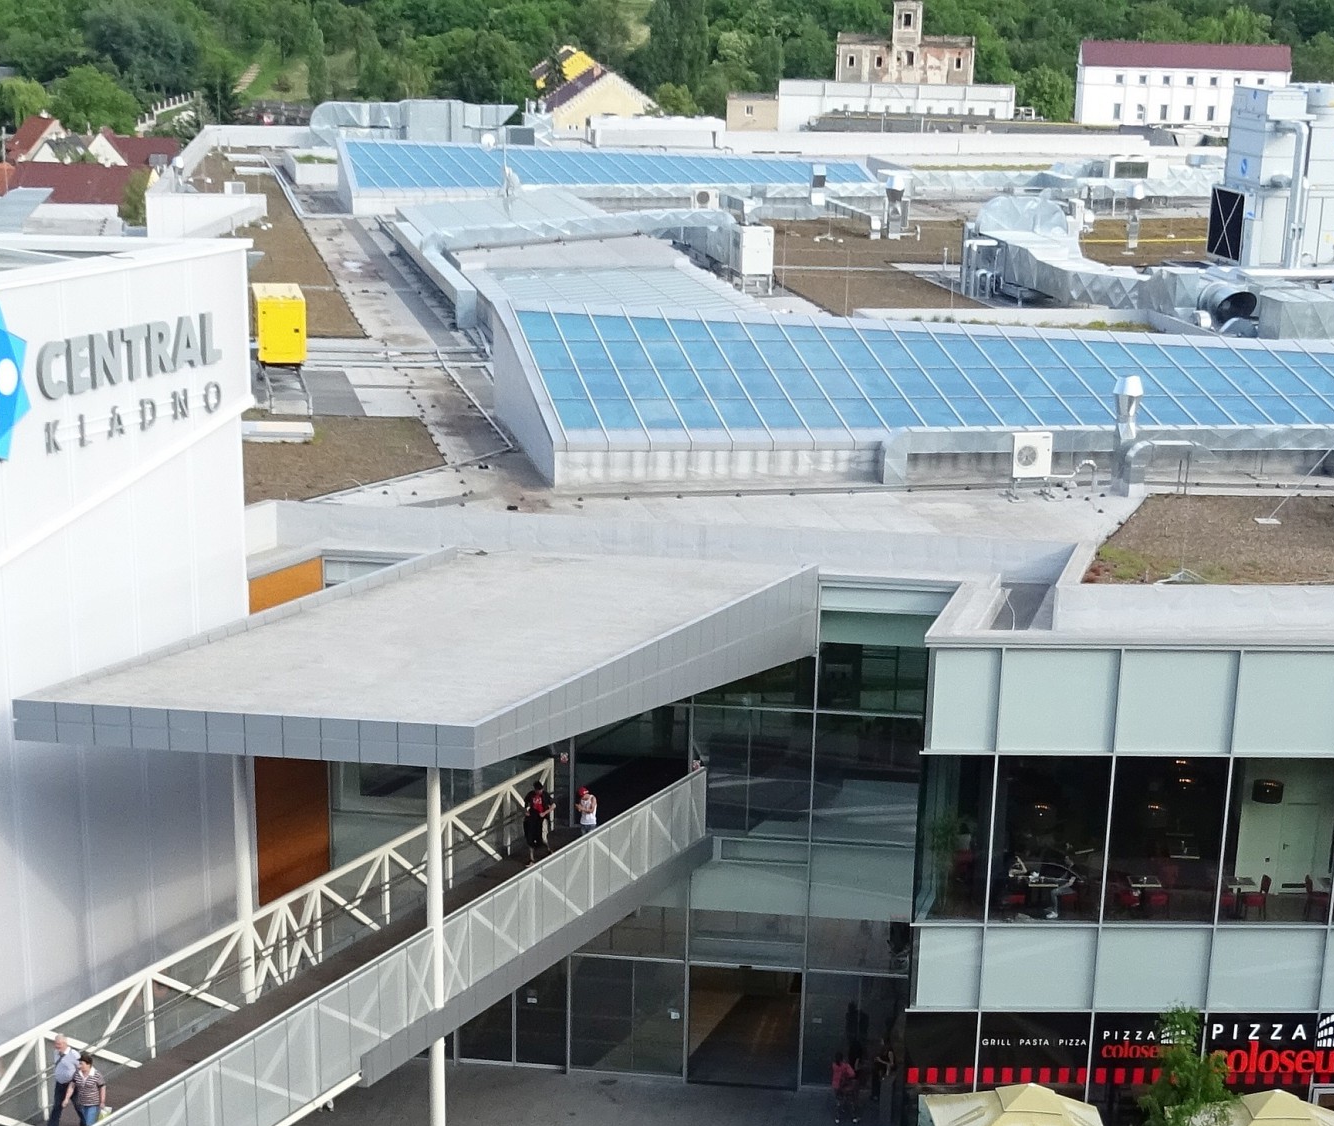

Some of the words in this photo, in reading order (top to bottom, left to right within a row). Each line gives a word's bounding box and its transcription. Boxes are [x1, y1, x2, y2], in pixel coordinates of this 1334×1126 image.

[36, 311, 222, 401] CENTRAL
[44, 381, 222, 456] KLADNO
[1103, 1030, 1156, 1040] PIZZA
[1211, 1023, 1307, 1040] PIZZA
[981, 1038, 1011, 1046] GRILL
[1019, 1038, 1050, 1046] PASTA
[1058, 1038, 1087, 1046] PIZZA
[1101, 1041, 1175, 1059] colose
